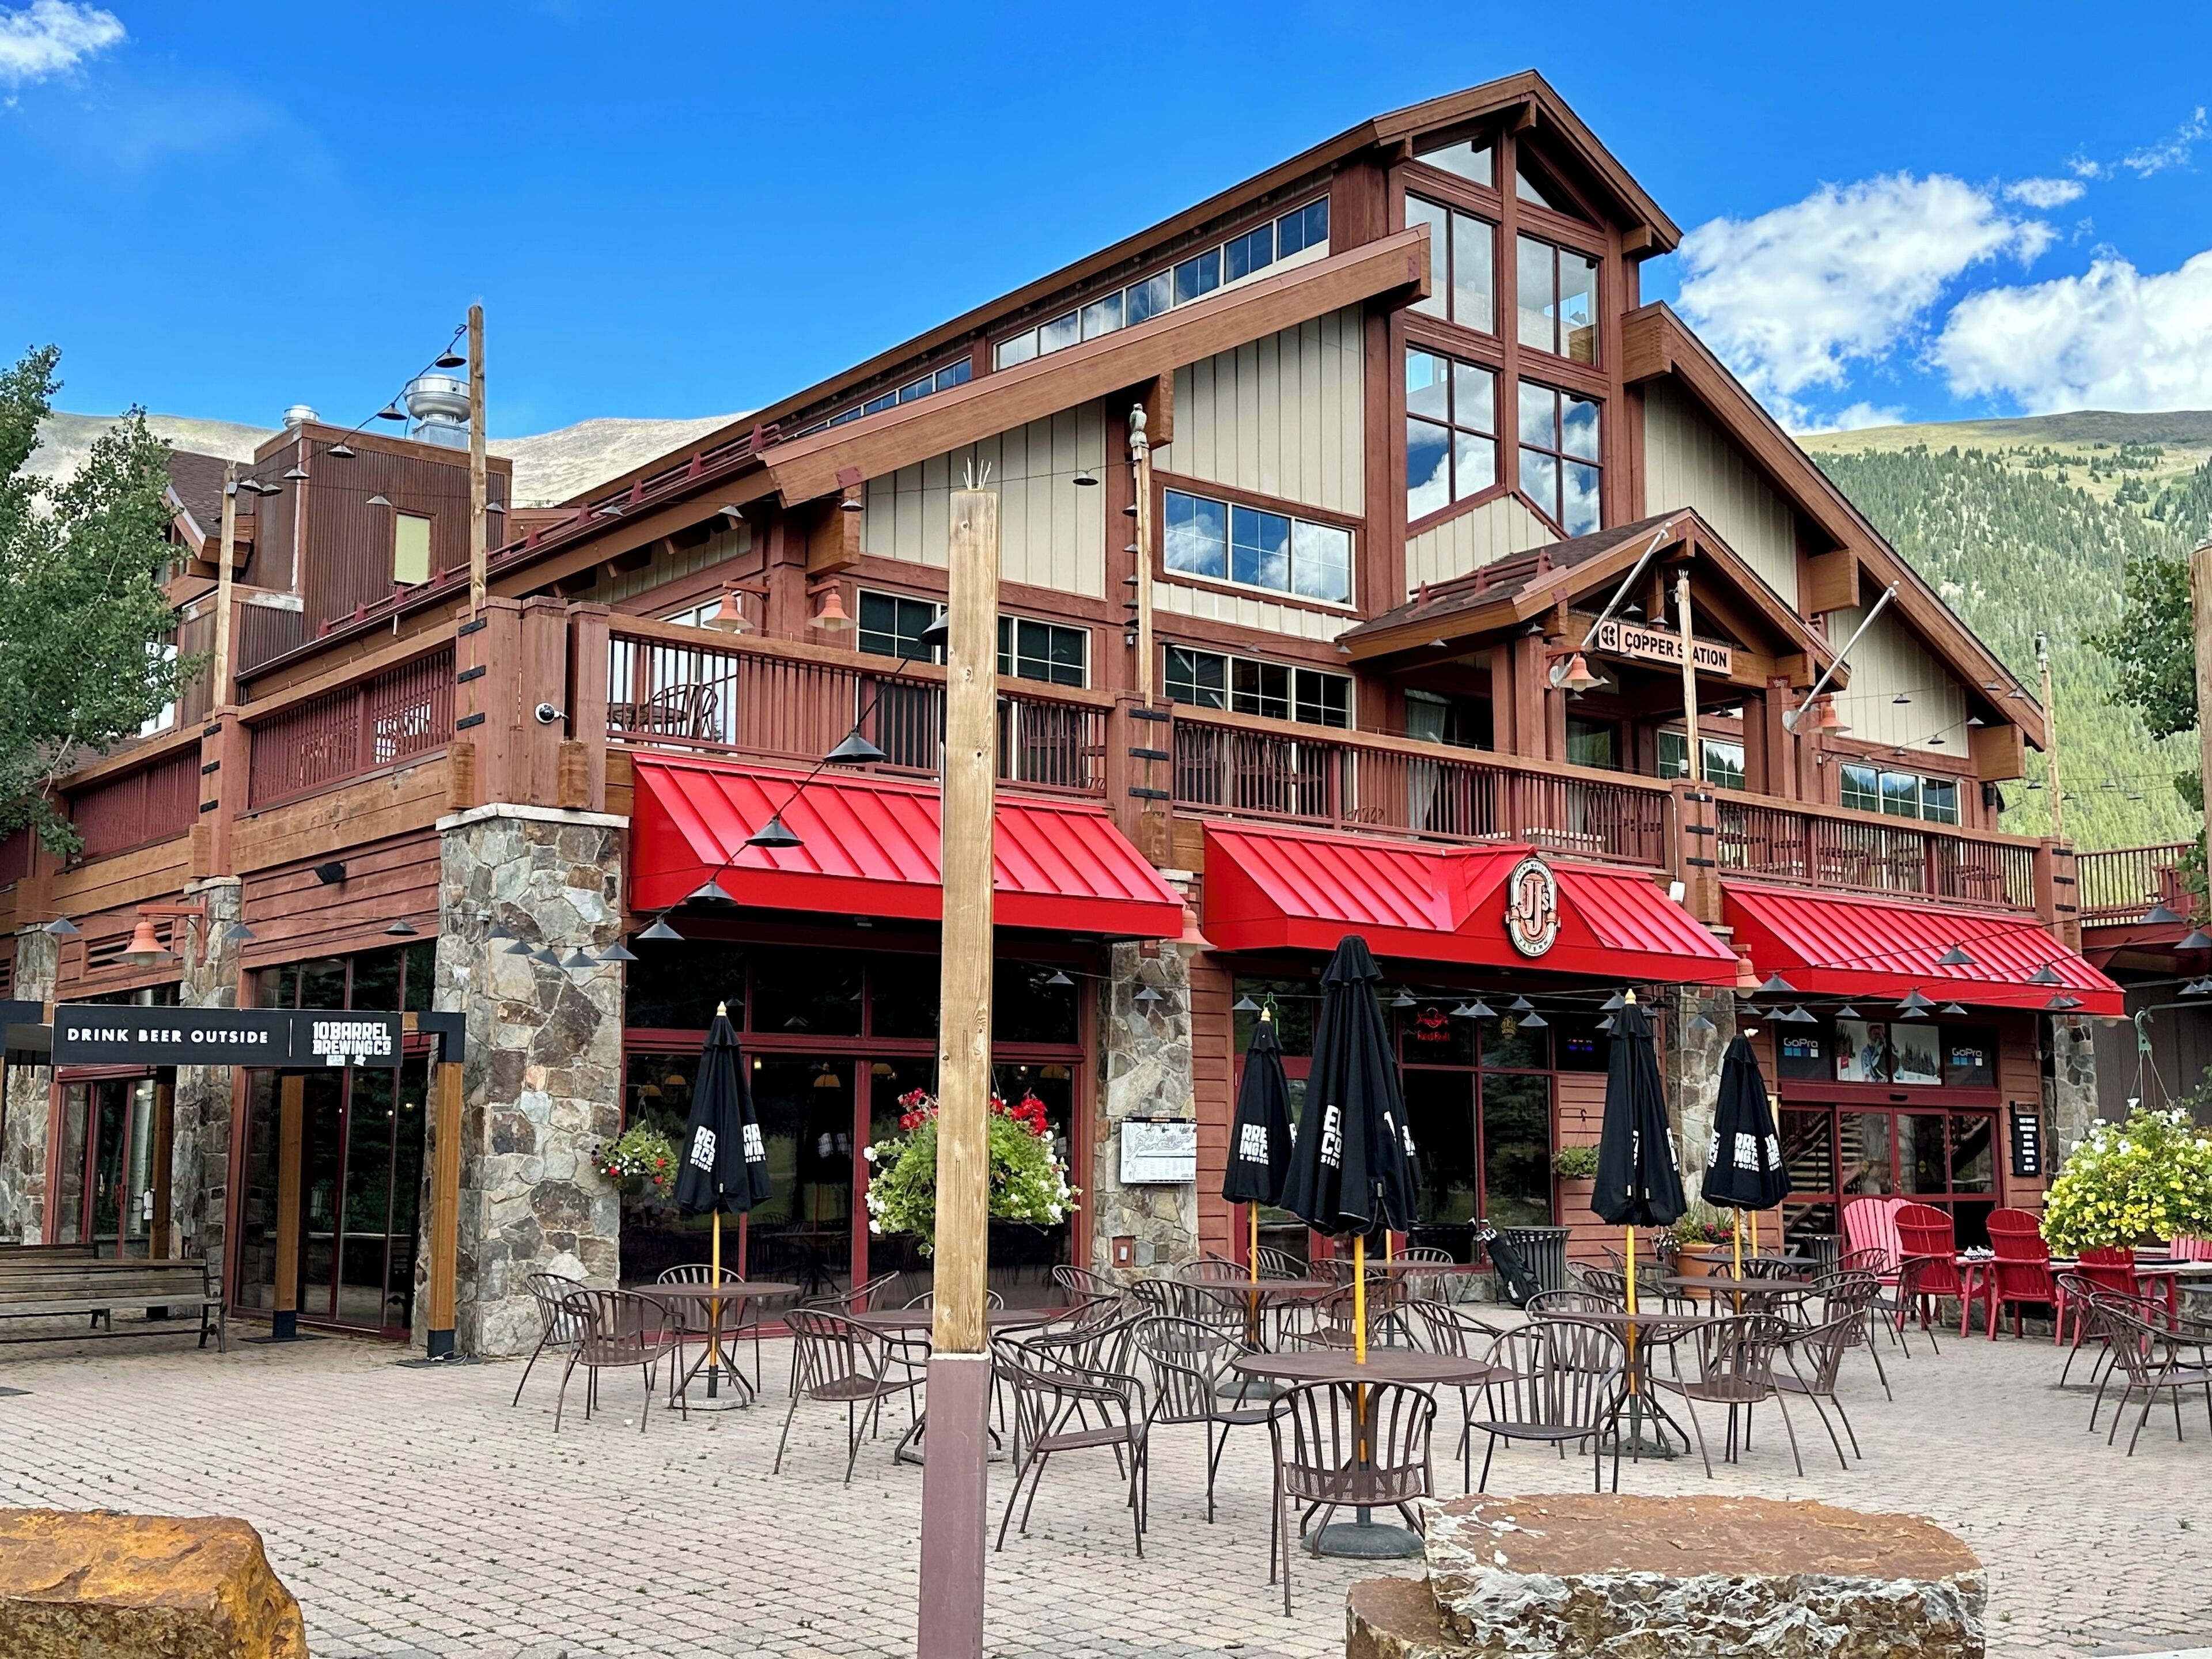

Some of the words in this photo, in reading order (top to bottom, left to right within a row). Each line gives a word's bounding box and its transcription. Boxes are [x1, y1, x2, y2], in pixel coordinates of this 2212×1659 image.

[1625, 632, 1674, 657] COPPER
[1677, 642, 1727, 668] SATION
[1518, 936, 1548, 952] TAVERN
[67, 1028, 129, 1041] DRINK
[138, 1029, 182, 1043] BEER
[191, 1030, 268, 1044] OUTSIDE
[1783, 1037, 1819, 1048] GoPro
[1952, 1047, 1983, 1058] GoPro
